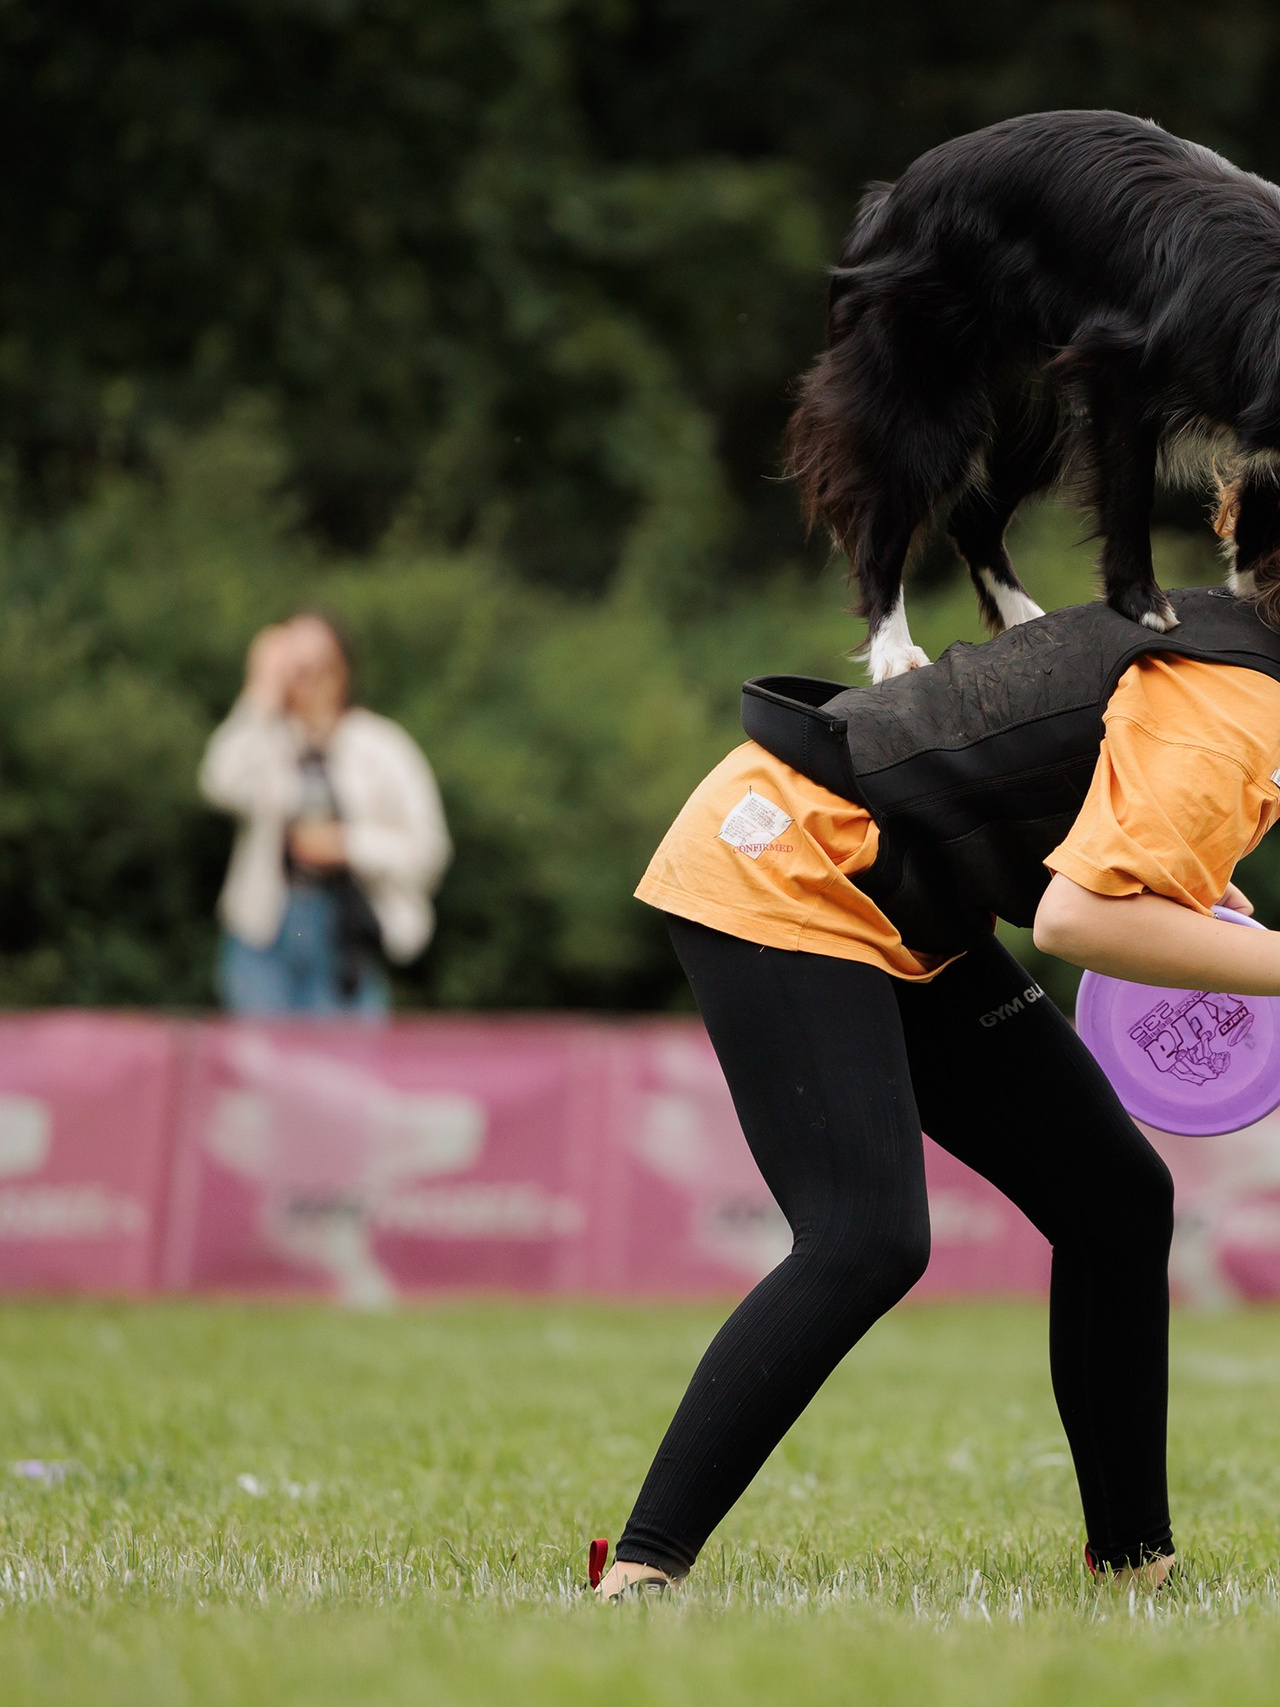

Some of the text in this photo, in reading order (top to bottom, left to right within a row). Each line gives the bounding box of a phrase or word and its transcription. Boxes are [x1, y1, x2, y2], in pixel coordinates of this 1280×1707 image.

[732, 843, 794, 854] CONFIRMED
[979, 997, 1025, 1028] GYM
[1130, 1002, 1174, 1044] 235
